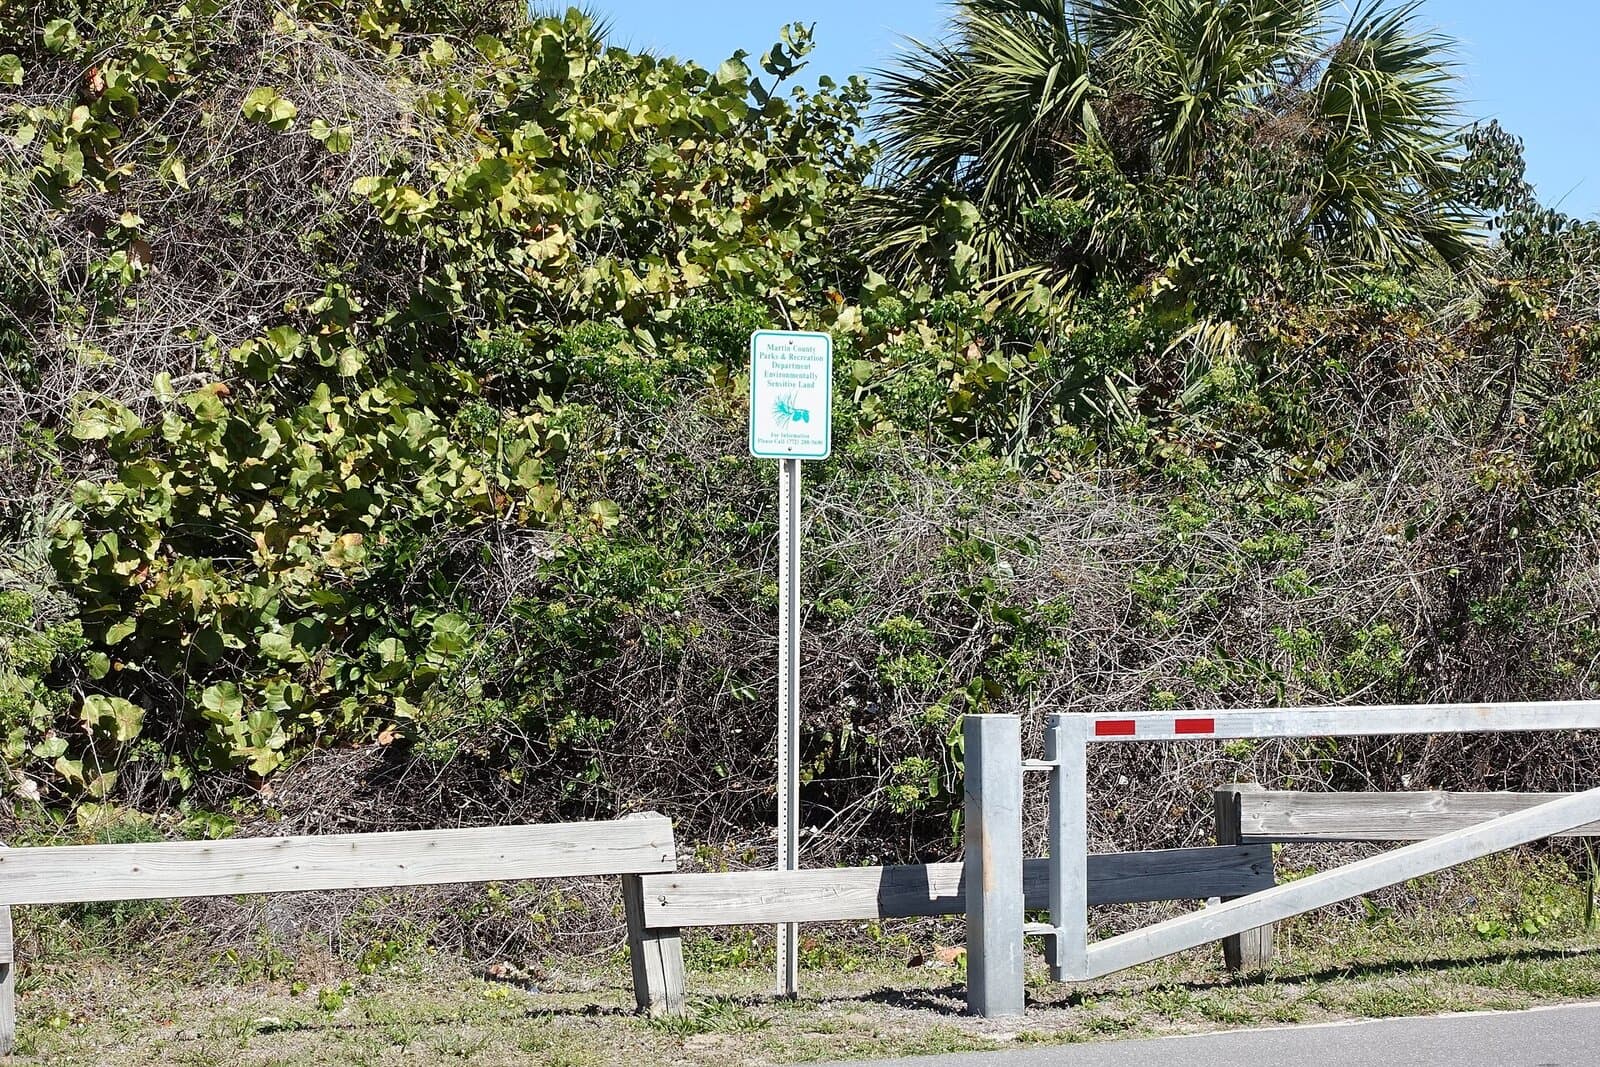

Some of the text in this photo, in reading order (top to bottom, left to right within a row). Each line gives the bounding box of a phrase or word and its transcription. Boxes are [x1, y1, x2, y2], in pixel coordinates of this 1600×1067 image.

[767, 344, 816, 354] Martin County
[789, 353, 823, 361] Recreation
[772, 361, 811, 370] Department
[764, 369, 818, 380] Environmentally
